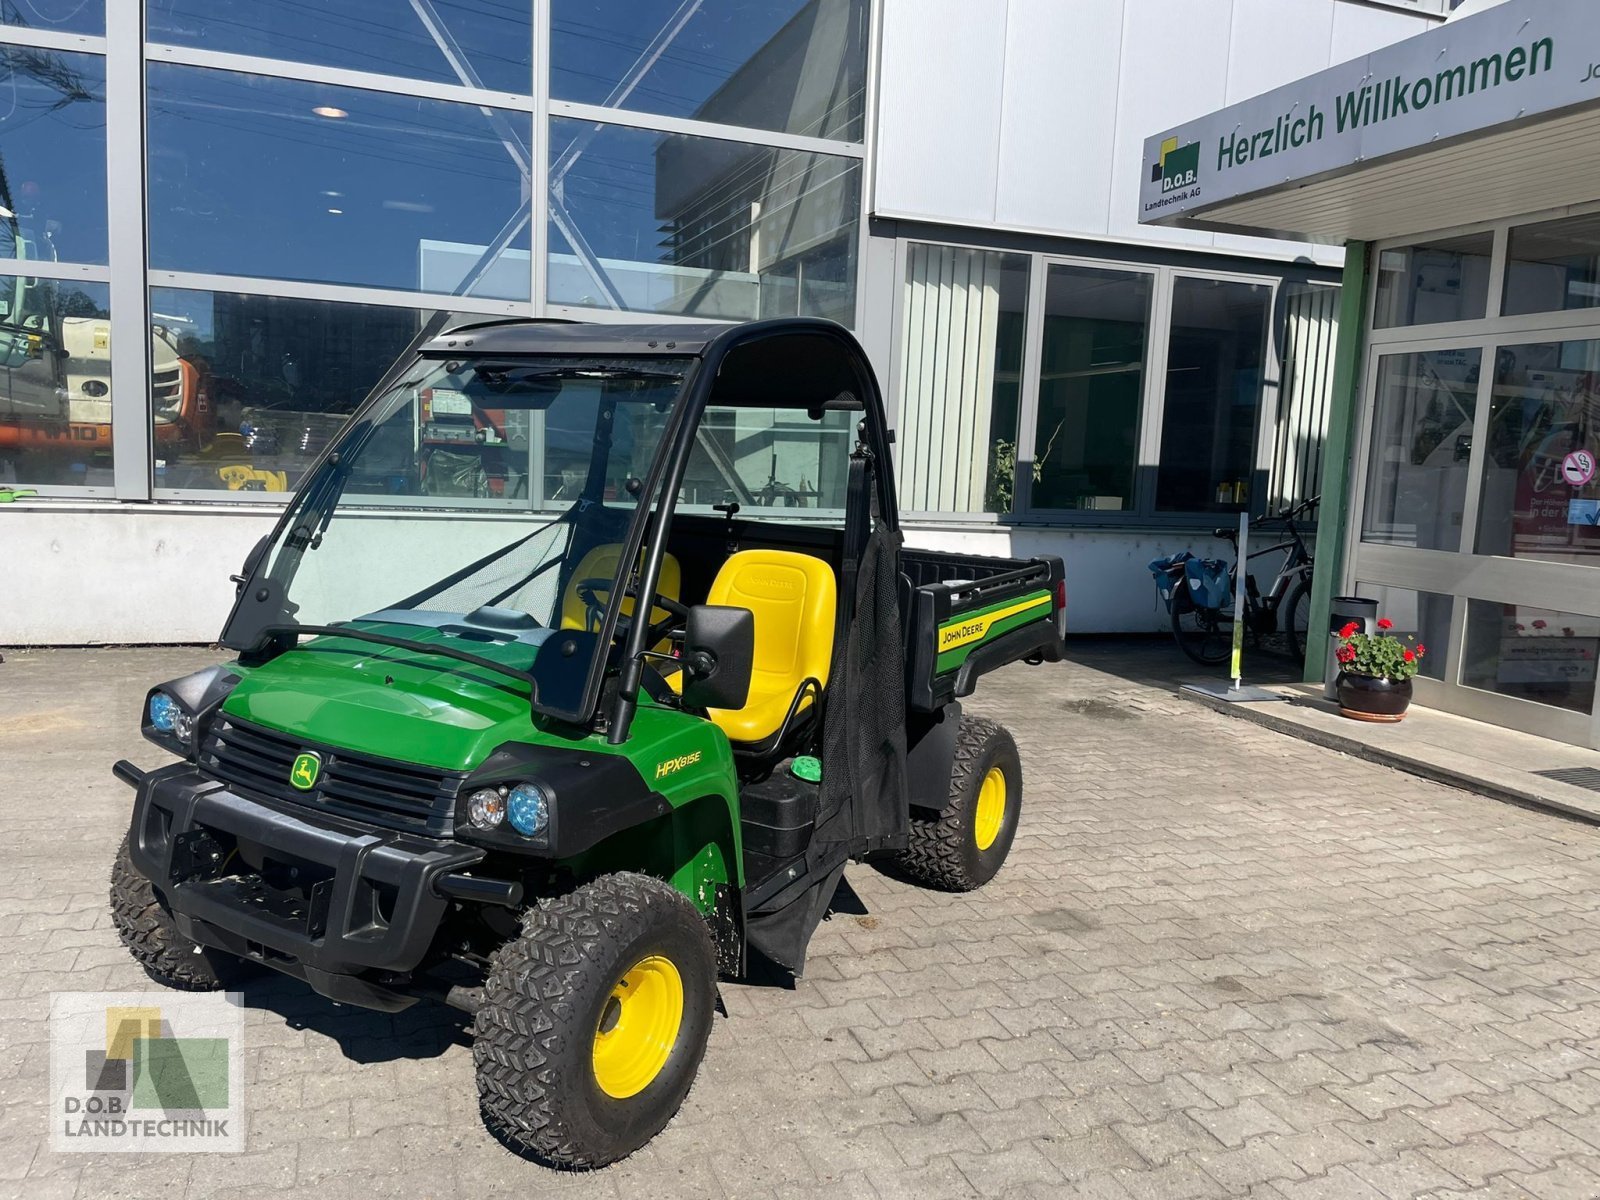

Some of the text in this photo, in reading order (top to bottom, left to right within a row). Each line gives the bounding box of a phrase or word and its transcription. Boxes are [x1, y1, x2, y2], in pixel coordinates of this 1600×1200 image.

[1217, 36, 1554, 171] Herzlich Willkommen
[1163, 169, 1197, 191] D.O.B.
[1144, 187, 1201, 212] Landtechnik AG
[942, 622, 983, 645] JOHN DEERE
[656, 750, 702, 779] HPX815E
